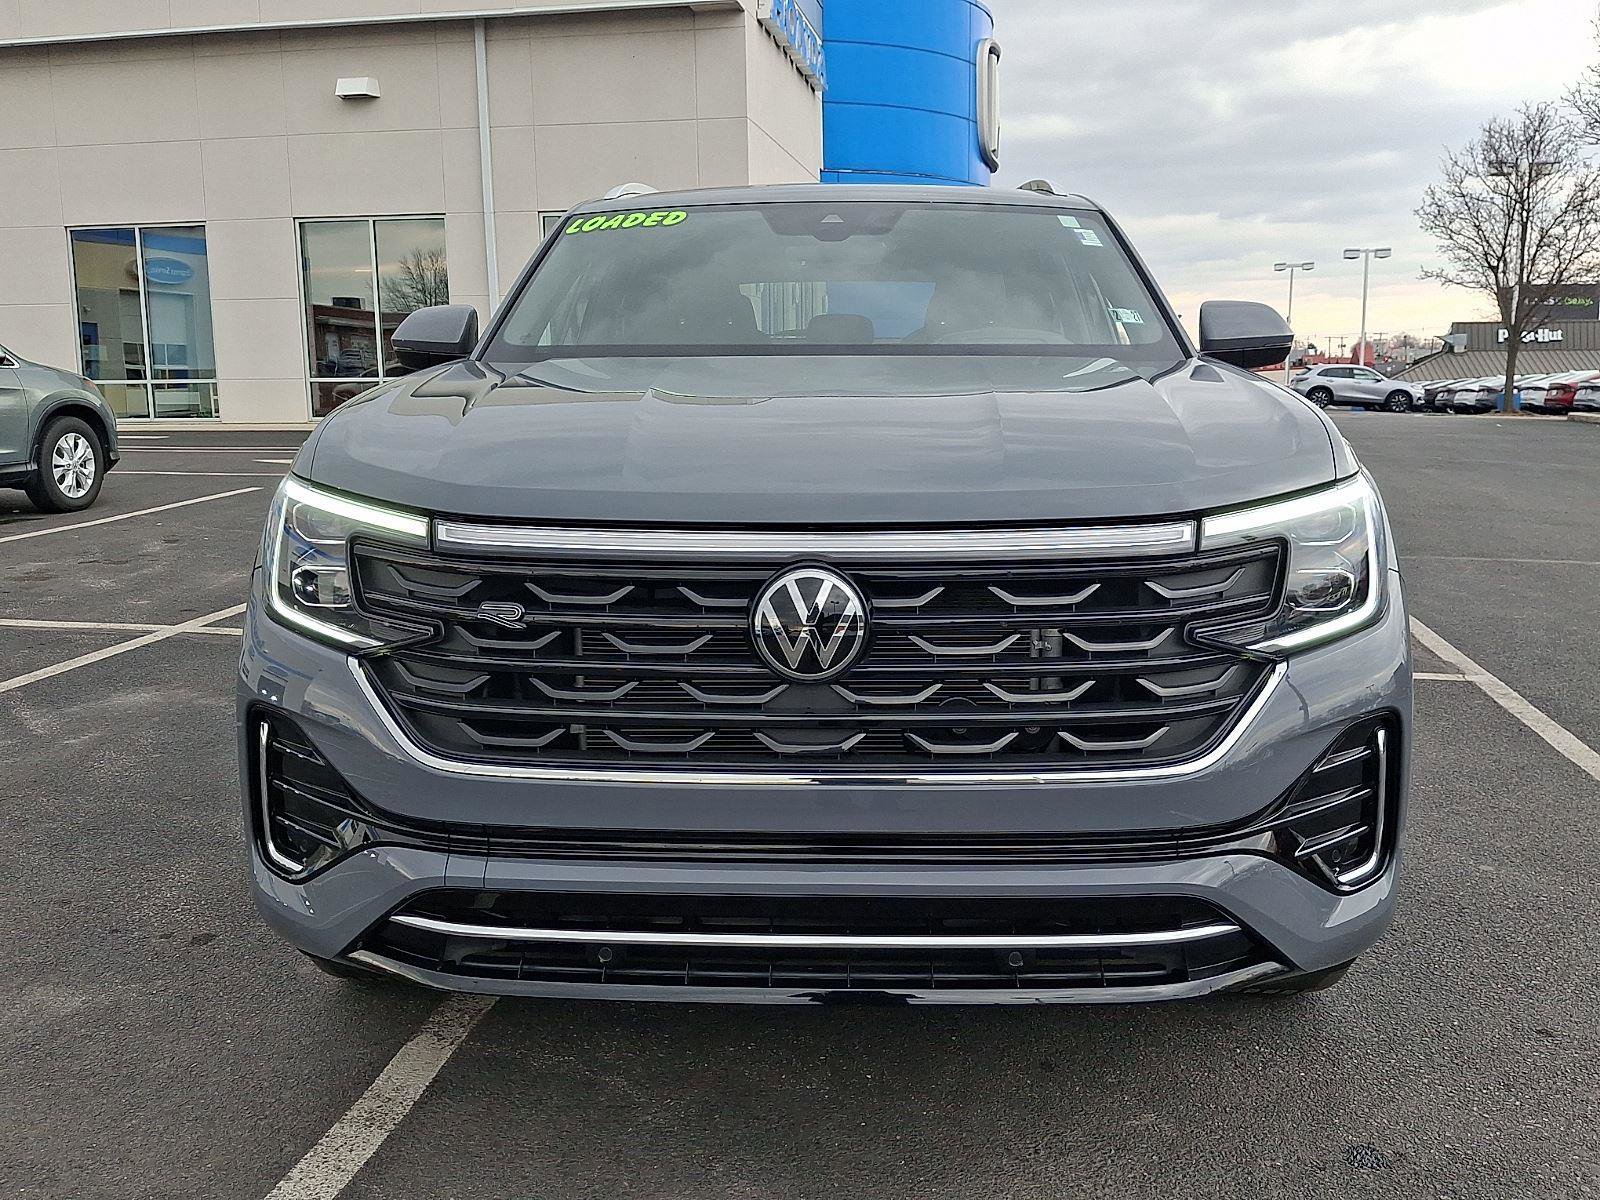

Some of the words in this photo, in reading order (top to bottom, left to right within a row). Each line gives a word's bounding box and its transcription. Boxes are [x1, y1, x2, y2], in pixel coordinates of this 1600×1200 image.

[565, 211, 688, 235] LOADED
[1498, 329, 1536, 343] Pza
[1537, 329, 1563, 343] Hut
